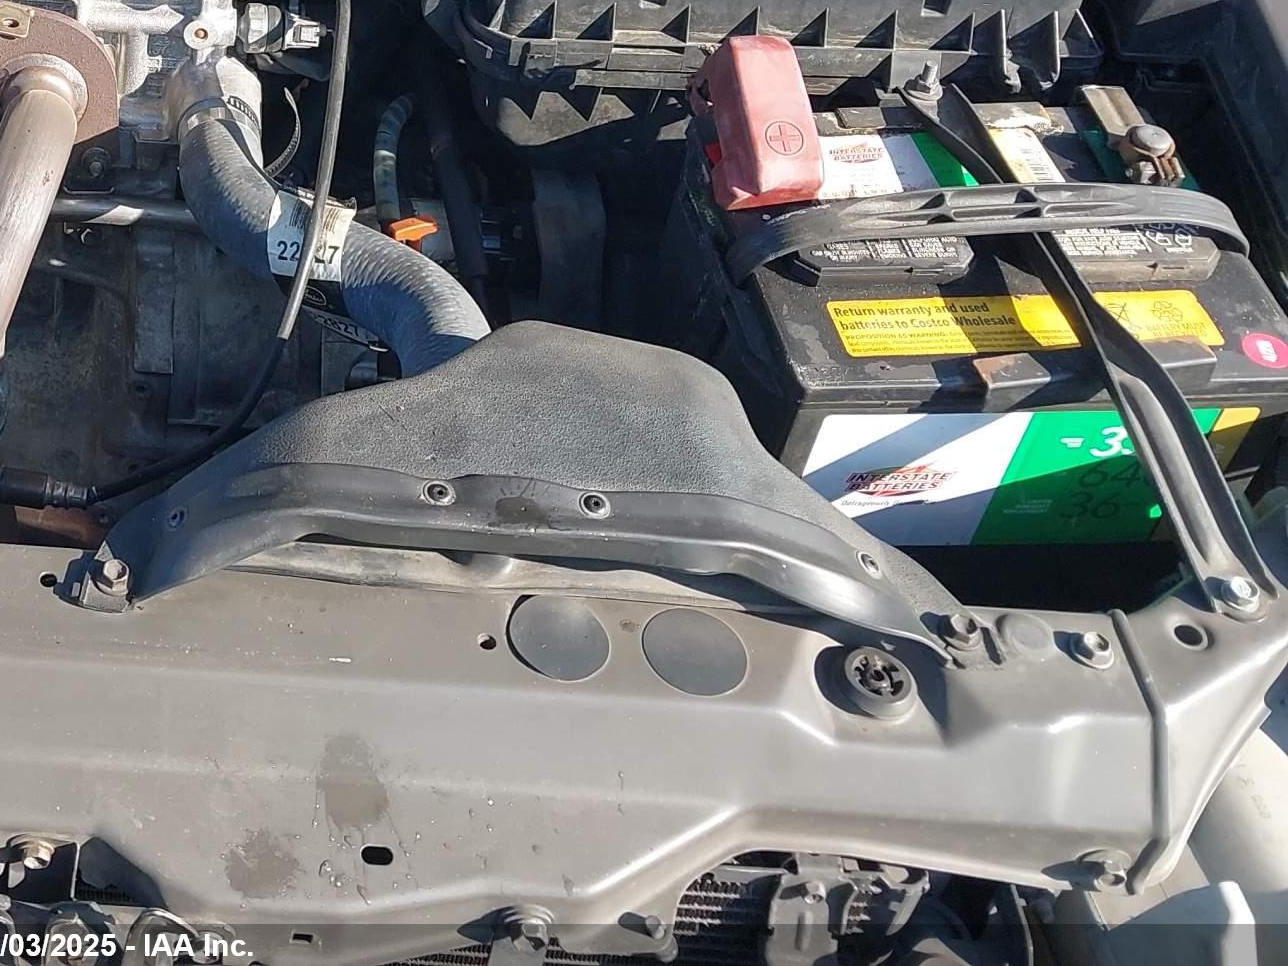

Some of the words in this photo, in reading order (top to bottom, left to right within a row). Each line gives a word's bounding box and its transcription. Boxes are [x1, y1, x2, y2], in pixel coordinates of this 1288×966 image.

[834, 307, 875, 318] Return
[877, 305, 931, 316] warranty
[934, 303, 957, 313] and
[959, 302, 989, 313] used
[840, 319, 894, 331] batteries
[895, 320, 909, 329] to
[910, 318, 950, 328] Costco
[951, 315, 1016, 327] Wholesale
[846, 472, 950, 483] INTERSTATE
[846, 481, 939, 491] BATTERIES
